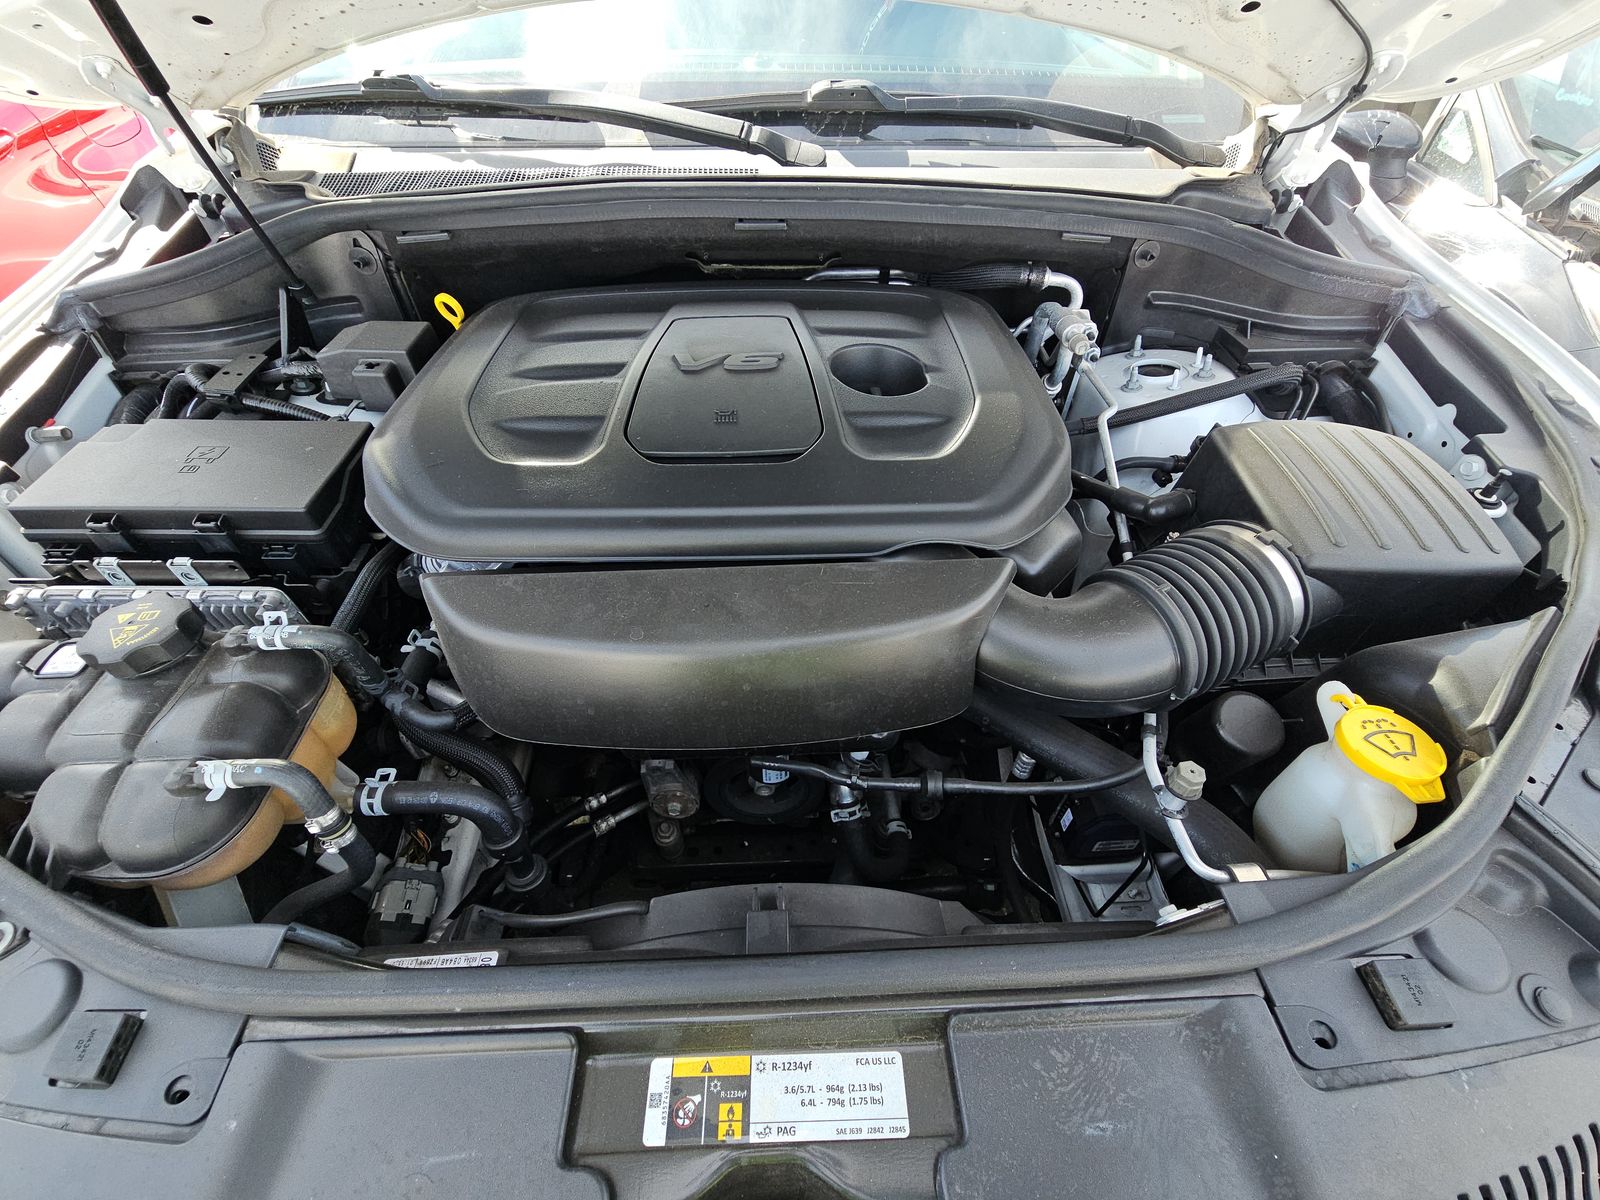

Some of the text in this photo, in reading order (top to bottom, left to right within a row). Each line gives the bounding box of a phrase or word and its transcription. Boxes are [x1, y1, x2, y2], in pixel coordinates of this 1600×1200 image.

[672, 351, 785, 373] V6
[855, 1056, 896, 1066] FCA US LLC
[771, 1060, 812, 1074] R-1234yf
[720, 1090, 747, 1099] R-1234yf
[784, 1084, 816, 1096] 3.6/5.7L
[825, 1085, 845, 1094] 964g
[848, 1082, 867, 1094] (2.13
[868, 1082, 883, 1093] lbs)
[800, 1098, 816, 1107] 6.4L
[827, 1098, 845, 1108] 794g
[849, 1096, 868, 1107] (1.75
[869, 1096, 884, 1106] lbs)
[776, 1126, 796, 1137] PAG
[835, 1128, 848, 1136] SAE
[867, 1127, 884, 1135] J2842
[889, 1126, 906, 1134] J2845
